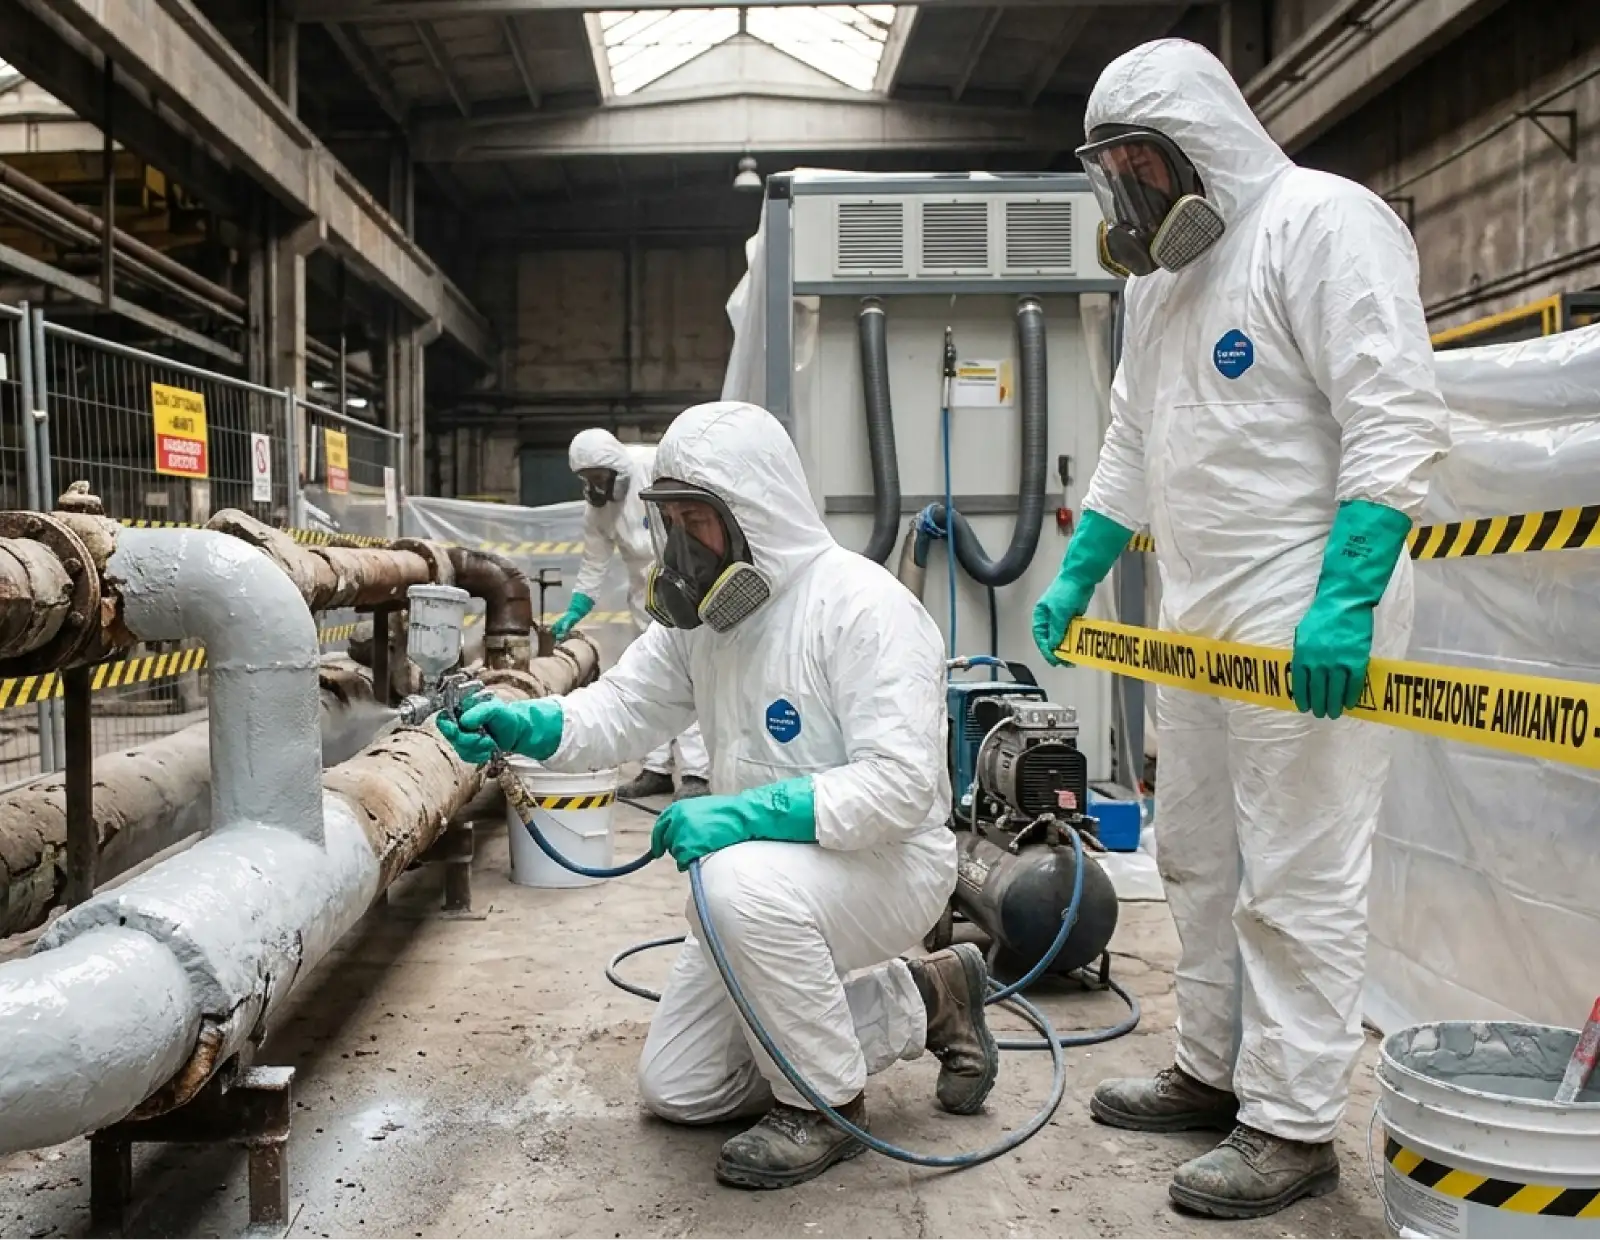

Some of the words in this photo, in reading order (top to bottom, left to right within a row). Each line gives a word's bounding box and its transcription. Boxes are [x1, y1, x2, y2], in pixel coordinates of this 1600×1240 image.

[1206, 650, 1260, 694] LAVORI
[1263, 659, 1281, 697] IN
[1383, 672, 1490, 730] ATTENZIONE
[1491, 688, 1589, 748] AMIANTO
